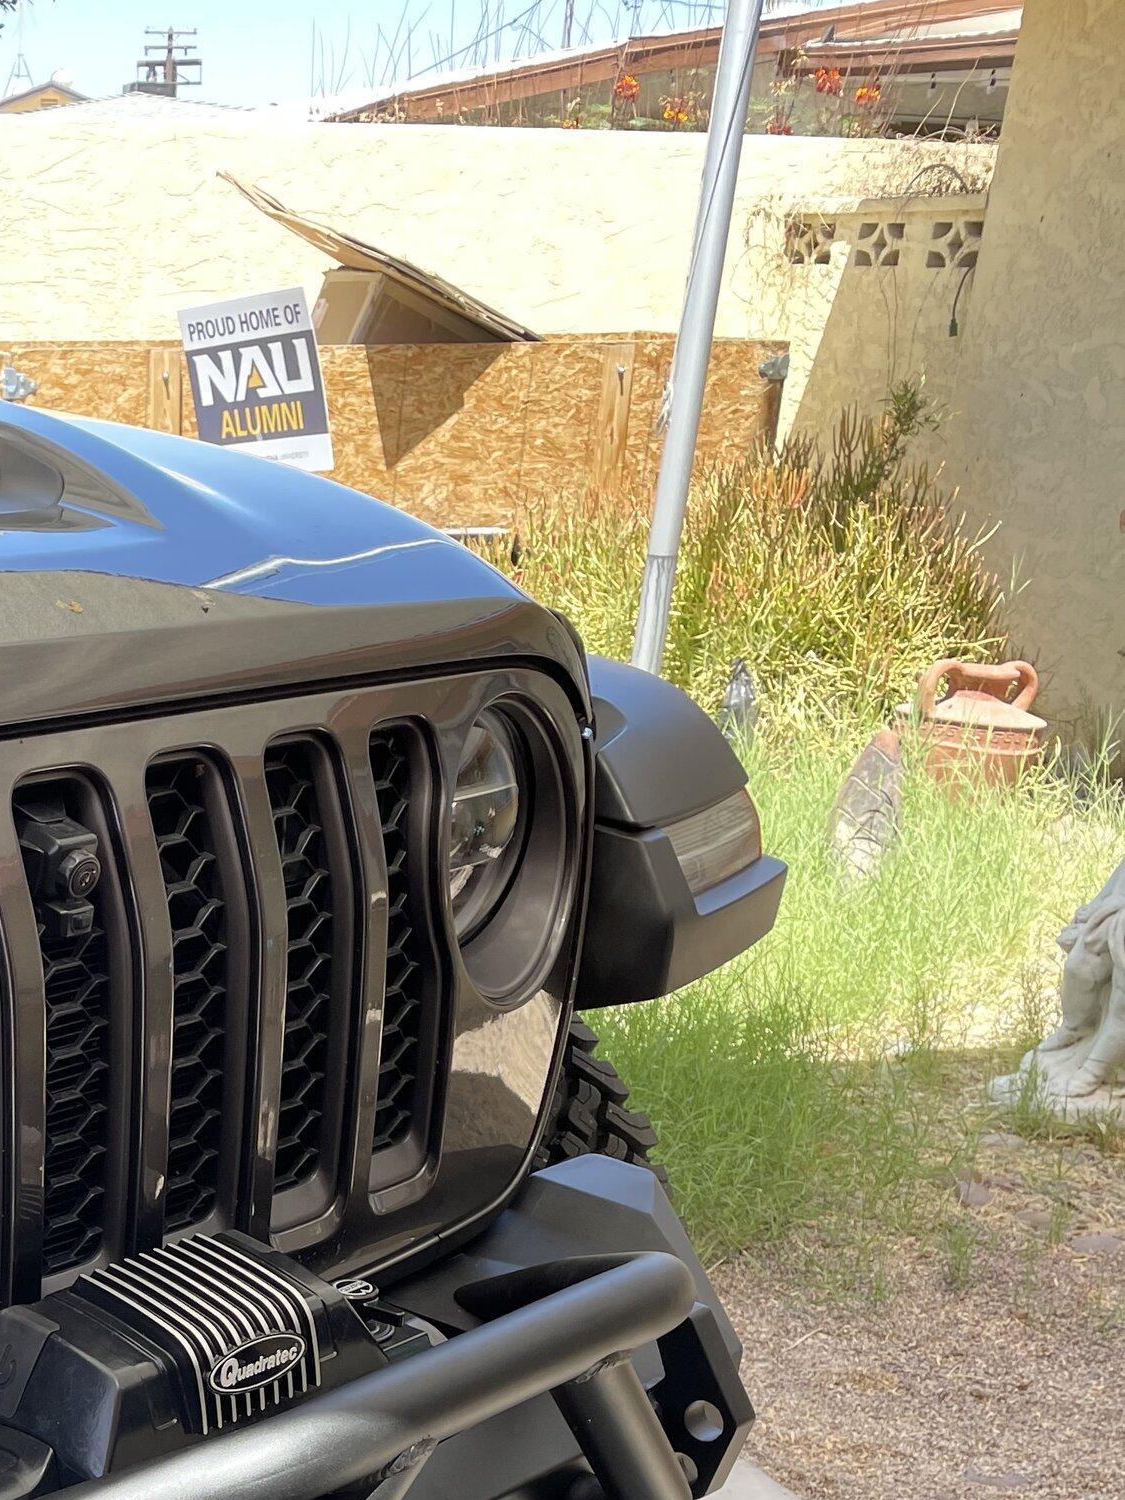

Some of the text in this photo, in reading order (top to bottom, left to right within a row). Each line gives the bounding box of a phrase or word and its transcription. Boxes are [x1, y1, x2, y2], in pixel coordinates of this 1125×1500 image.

[187, 303, 301, 342] PROUD HOME OF
[192, 337, 315, 407] NAU
[221, 400, 304, 439] ALUMNI
[219, 1344, 298, 1388] Quadratec
